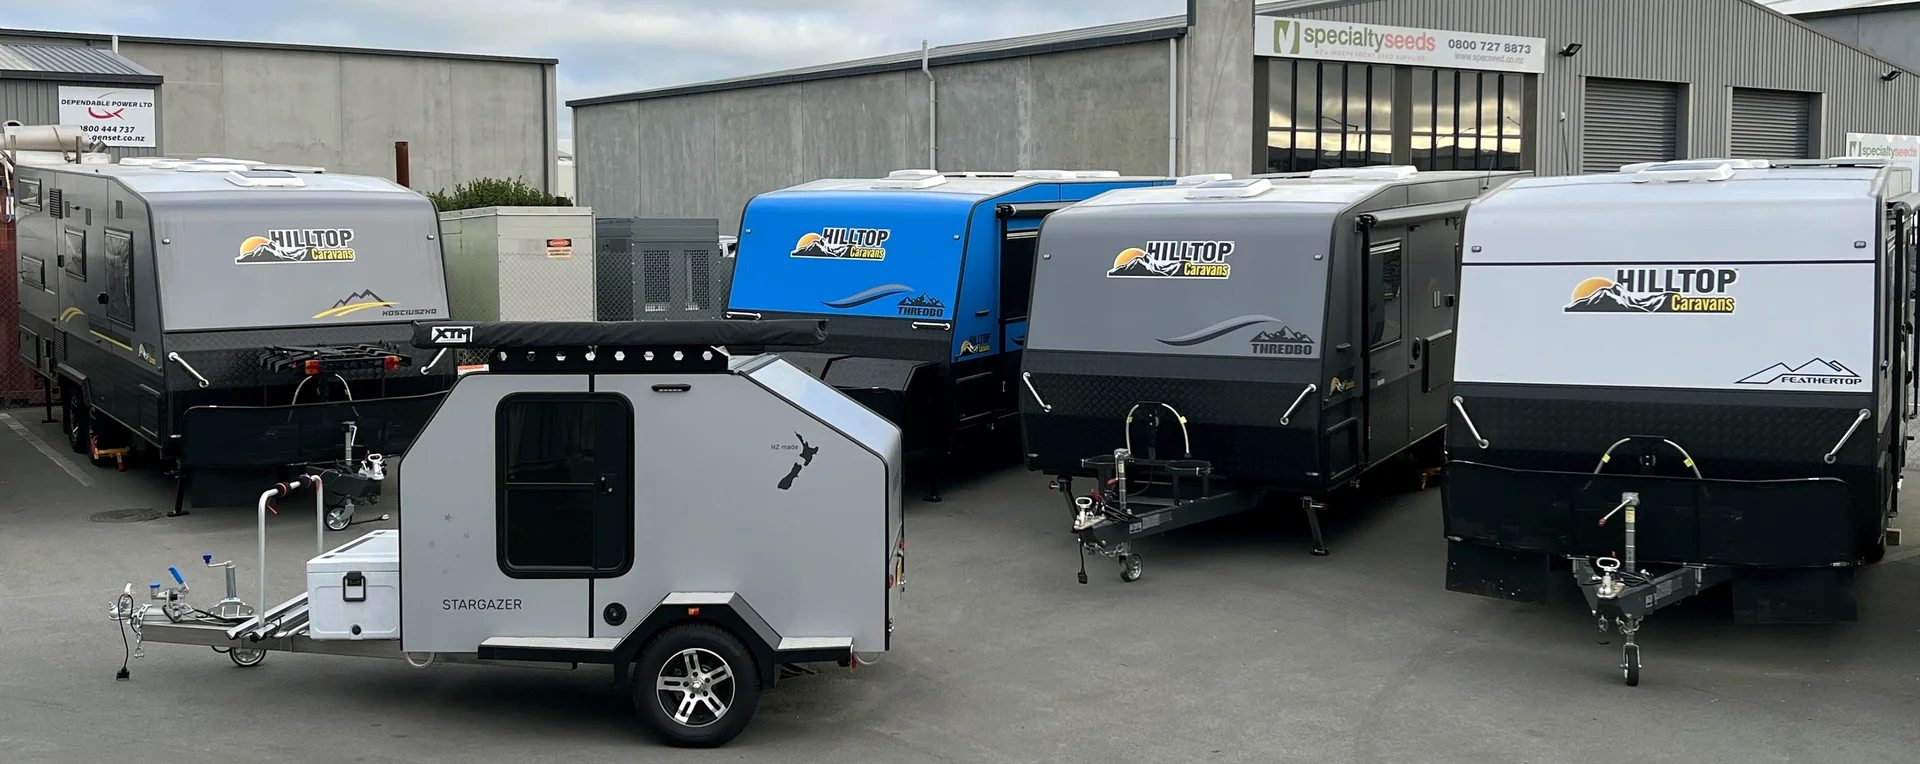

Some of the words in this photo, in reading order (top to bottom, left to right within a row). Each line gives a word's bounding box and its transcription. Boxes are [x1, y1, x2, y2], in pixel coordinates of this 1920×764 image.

[1304, 25, 1436, 53] specialtyseeds
[1448, 39, 1477, 50] 0800
[1480, 41, 1501, 52] 727
[1504, 43, 1532, 54] 8873
[1330, 50, 1375, 59] INDEPENDENT
[1455, 53, 1524, 65] www.specseed.co.nz
[61, 99, 110, 107] DEPENDABLE
[112, 100, 138, 108] POWER
[88, 134, 146, 142] .genset.co.nz
[1862, 144, 1917, 160] specialtyseeds
[270, 229, 352, 248] HILLTOP
[823, 228, 889, 247] HILLTOP
[311, 247, 354, 260] Caravans
[850, 245, 885, 259] Caravans
[1147, 241, 1232, 262] HILLTOP
[1184, 262, 1228, 276] Caravans
[1617, 268, 1737, 294] HILLTOP
[1671, 294, 1734, 311] Caravans
[382, 308, 437, 316] KOSCIUSZKO
[898, 306, 944, 317] THREDBO
[431, 327, 472, 343] XTM
[1251, 343, 1312, 355] THREDBO
[1781, 376, 1862, 385] FEATHERTOP
[443, 599, 522, 610] STARGAZER
